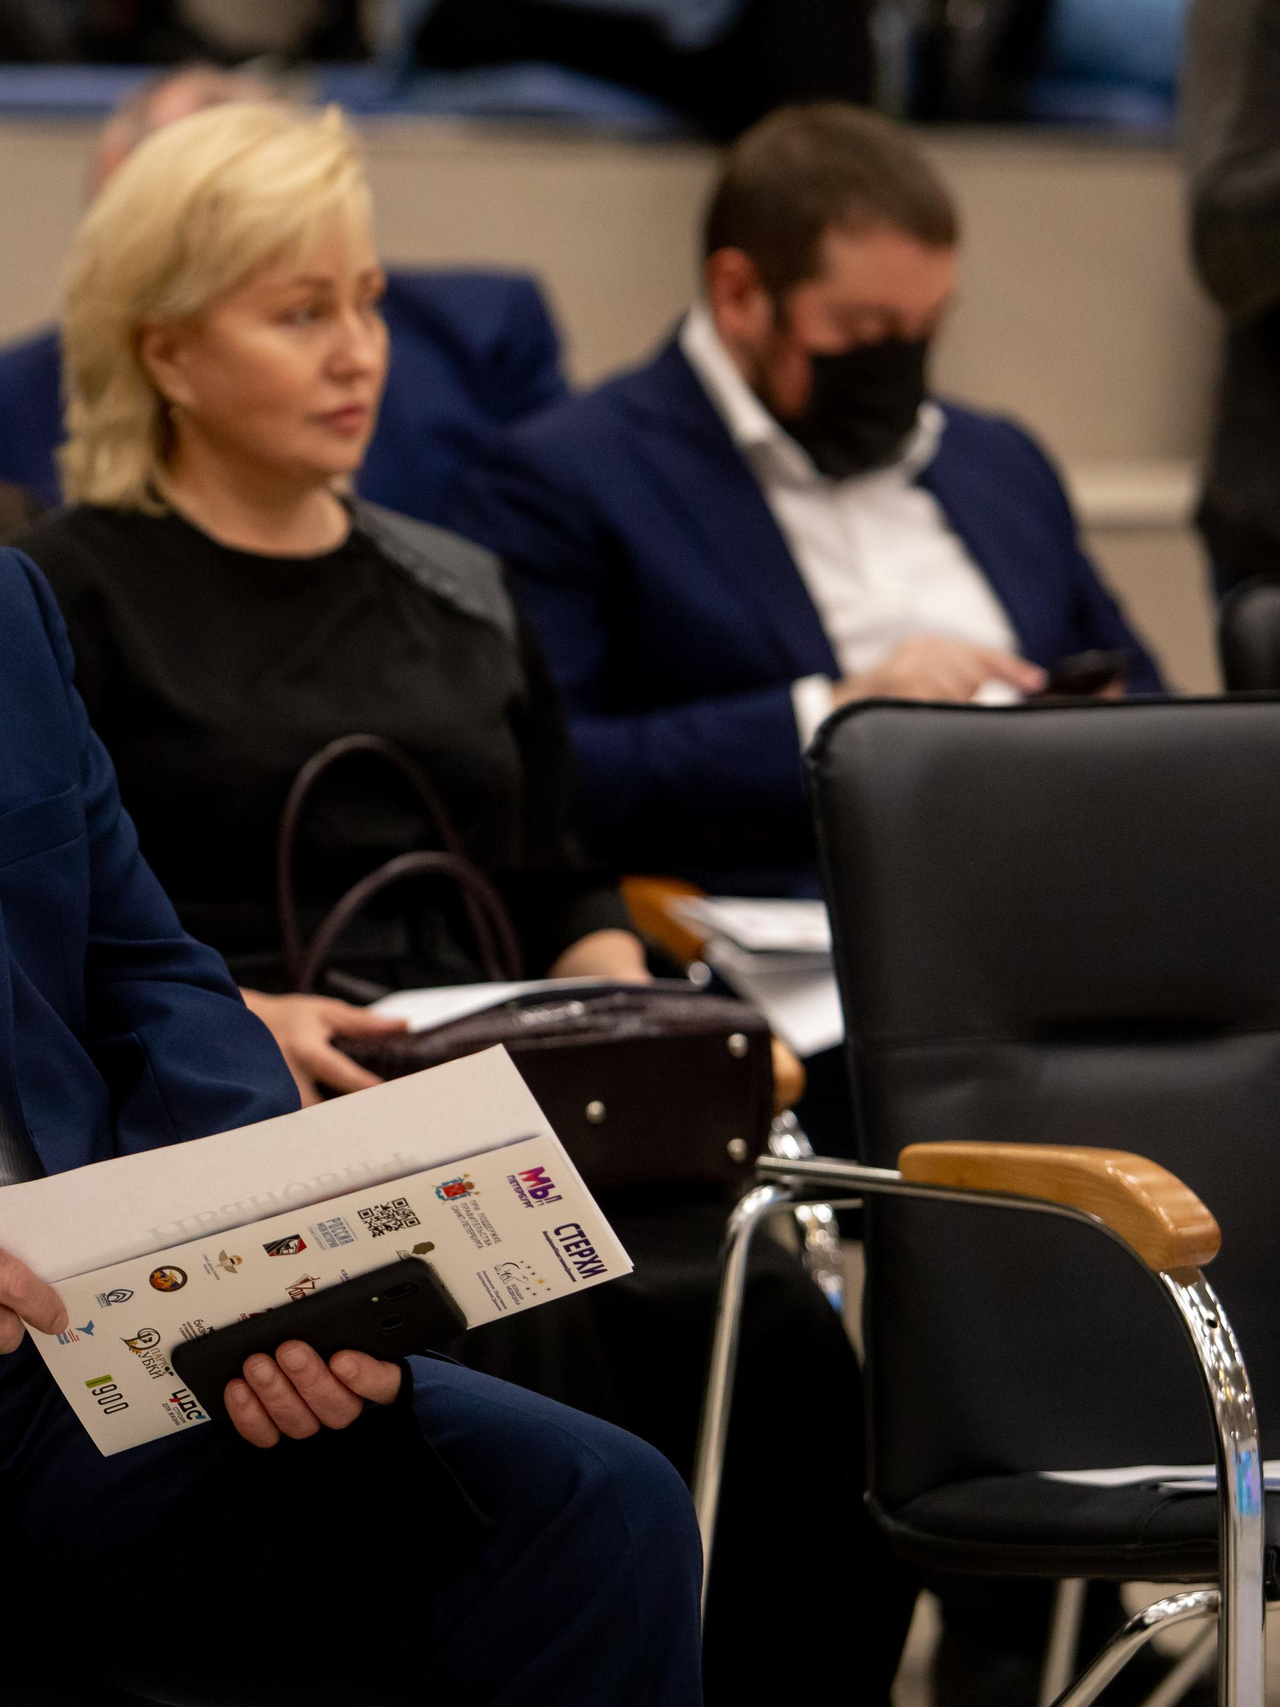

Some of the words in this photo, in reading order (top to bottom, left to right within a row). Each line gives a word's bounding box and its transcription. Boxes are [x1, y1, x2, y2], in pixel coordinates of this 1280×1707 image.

[506, 1174, 535, 1209] ПЕТЕРБУРГ
[450, 1205, 483, 1250] САНКТ-ПЕТЕРБУРГА
[460, 1202, 493, 1247] ПРАВИТЕЛЬСТВА
[470, 1199, 482, 1212] ПРИ
[477, 1211, 502, 1244] ПОДДЕРЖКЕ
[553, 1222, 608, 1280] СТЕРХИ
[151, 1347, 168, 1368] ПАРК
[169, 1388, 206, 1421] ЦДС
